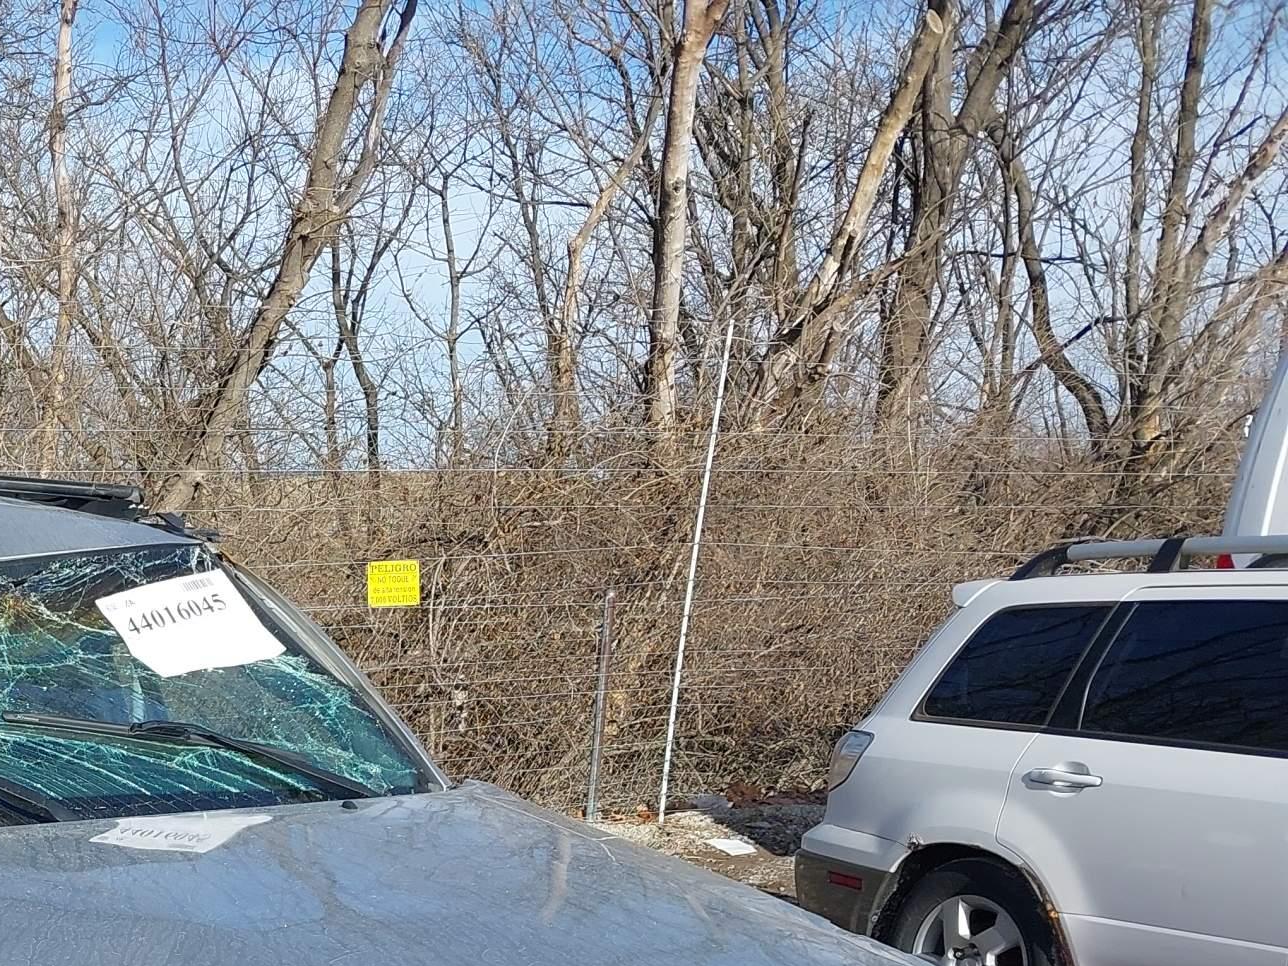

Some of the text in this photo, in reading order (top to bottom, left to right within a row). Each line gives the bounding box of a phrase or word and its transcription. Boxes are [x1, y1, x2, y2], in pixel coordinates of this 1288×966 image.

[371, 564, 417, 573] PELIGRO
[377, 575, 408, 584] NO TOQUE
[387, 594, 417, 604] VOLTIOS
[127, 593, 227, 634] 44016045
